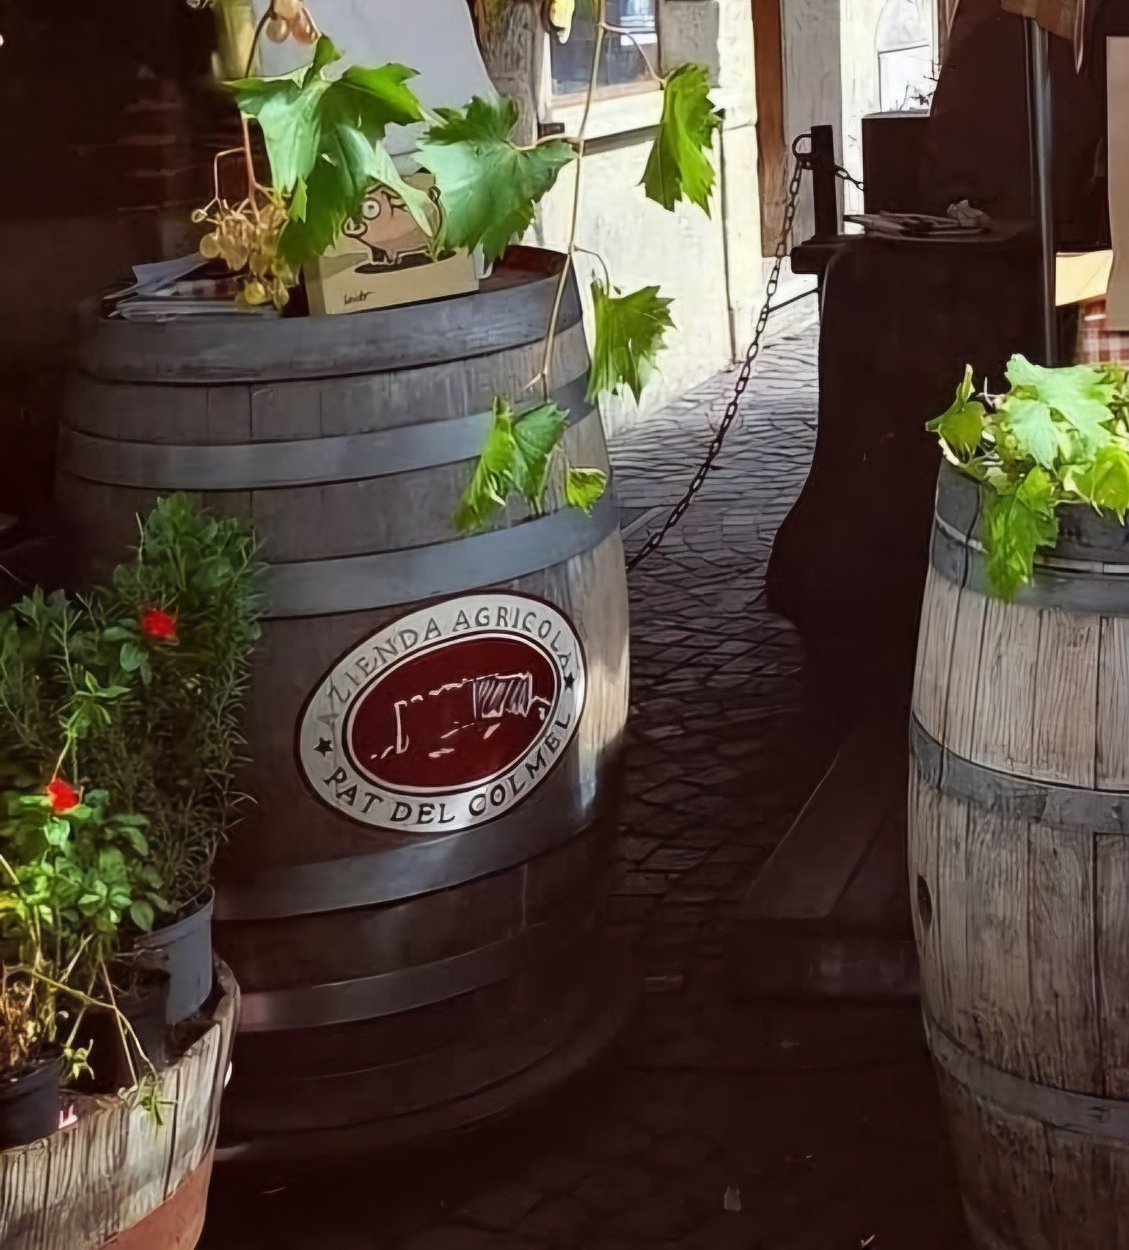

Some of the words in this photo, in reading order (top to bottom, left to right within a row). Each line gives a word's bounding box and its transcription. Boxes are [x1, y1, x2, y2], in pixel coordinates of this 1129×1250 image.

[452, 606, 572, 676] AGRICOLA
[389, 801, 456, 824] DEL
[467, 713, 571, 817] COLMEL
